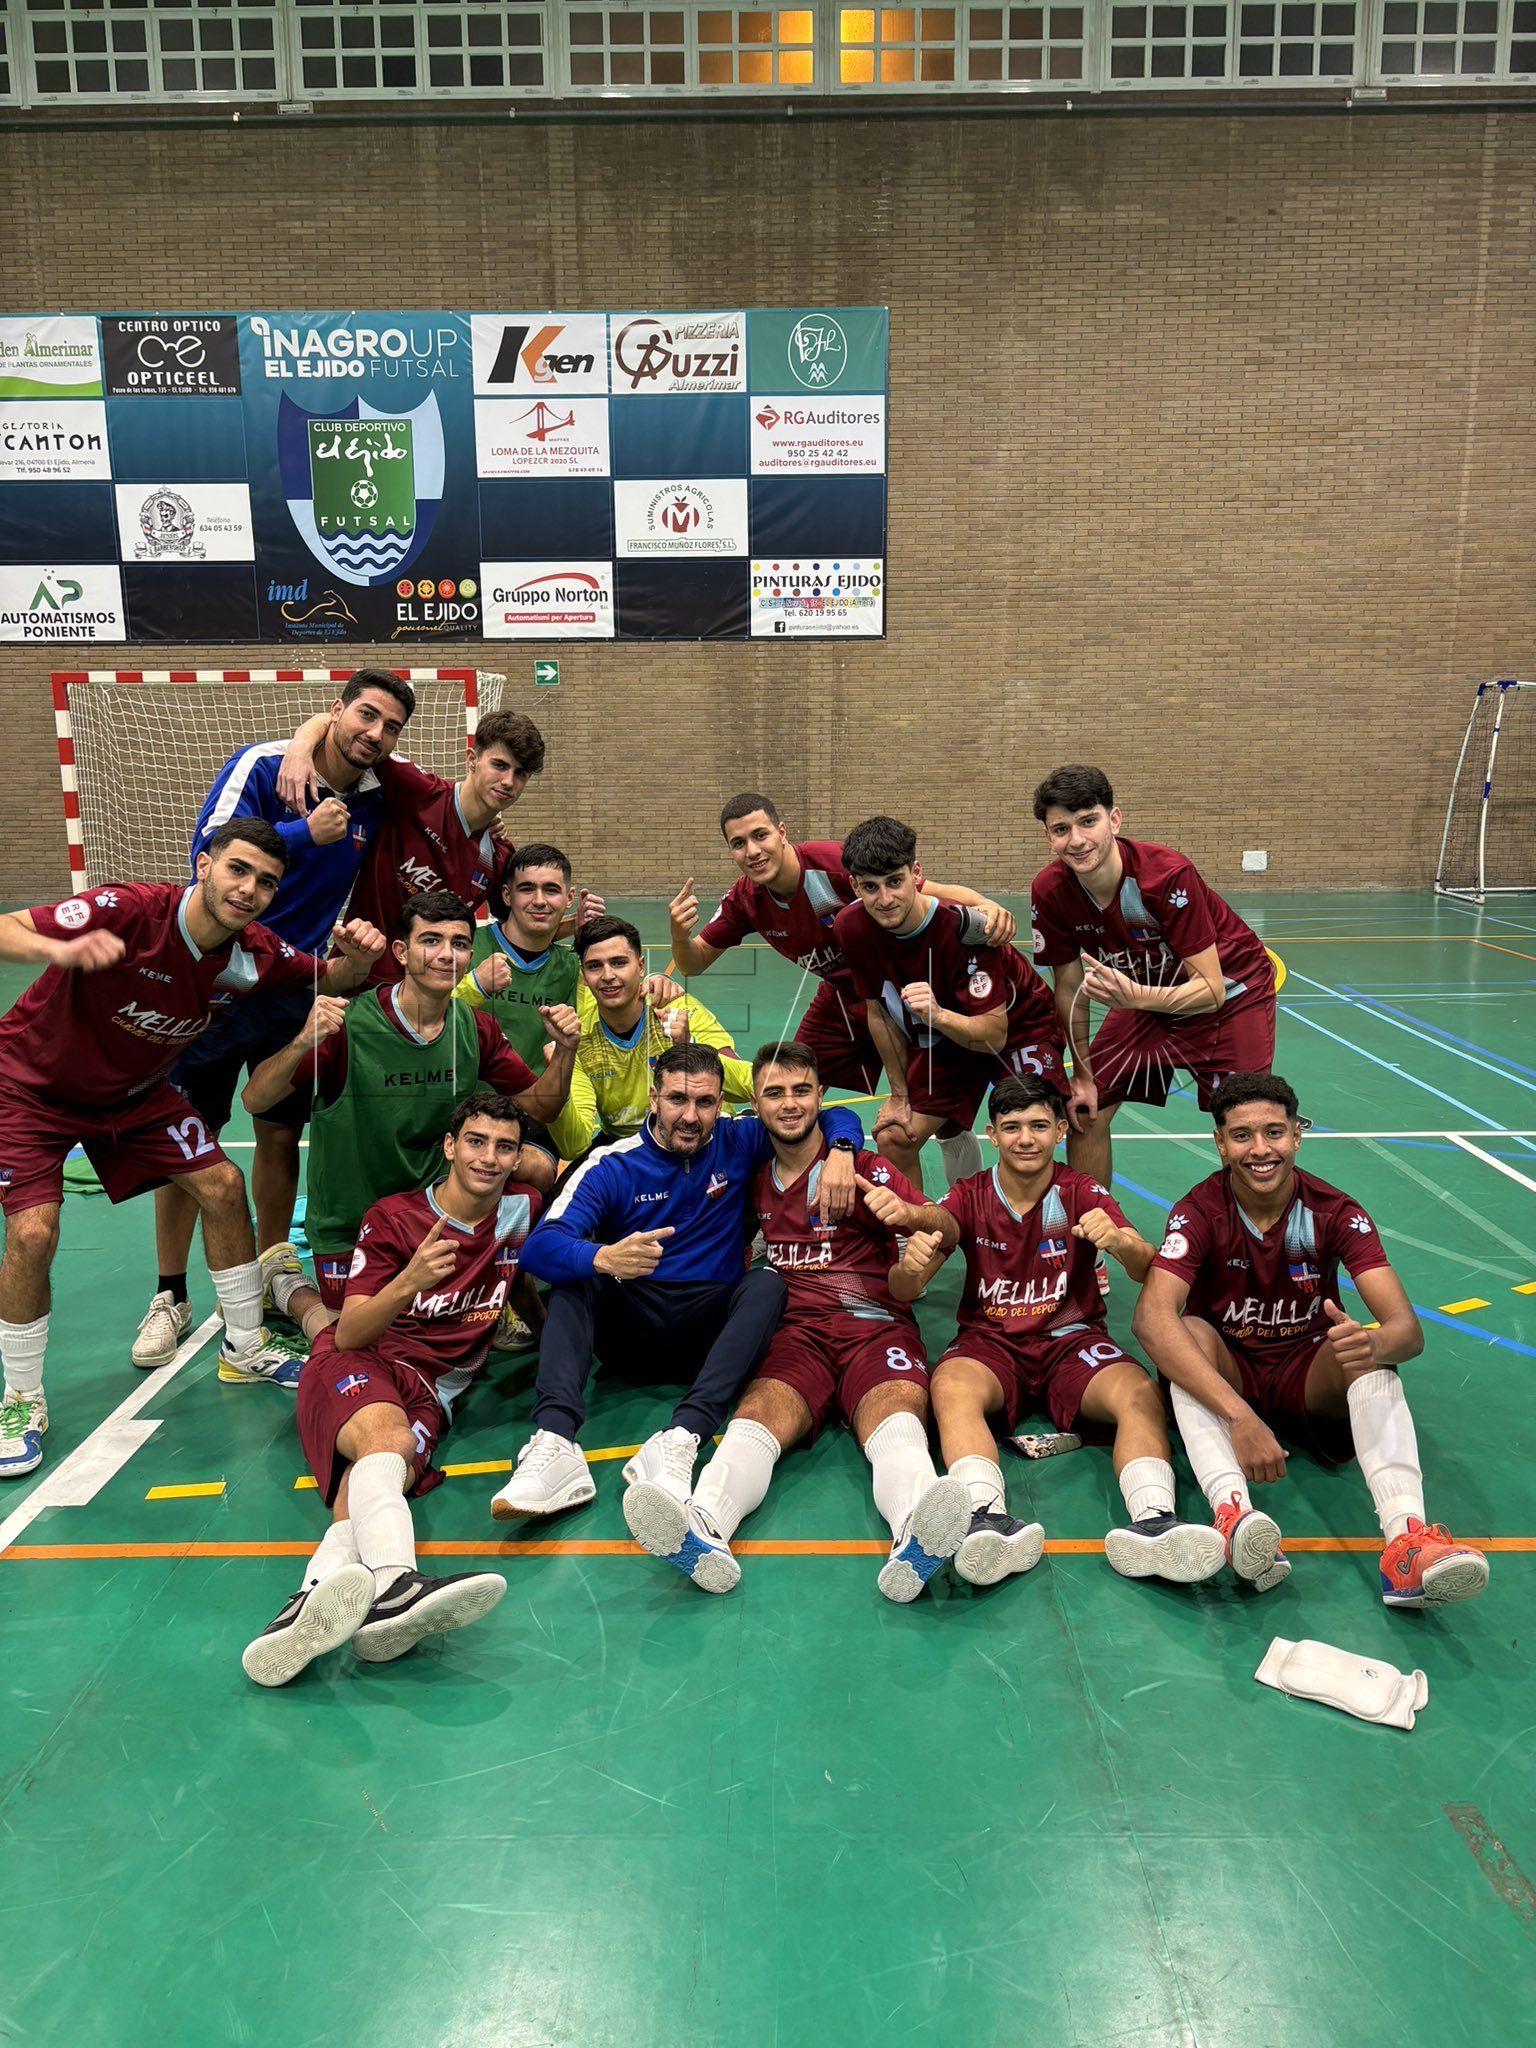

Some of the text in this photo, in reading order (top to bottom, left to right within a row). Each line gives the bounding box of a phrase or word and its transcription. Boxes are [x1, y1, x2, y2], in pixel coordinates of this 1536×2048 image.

[118, 320, 221, 332] CENTRO OPTICO
[675, 321, 740, 340] PIZZERIA
[24, 332, 93, 357] Almerimar
[39, 360, 93, 368] ORNAMENTALES
[264, 359, 459, 378] EL EJIDO FUTSAL
[127, 371, 220, 386] OPTICEEL
[668, 380, 741, 391] Almerimar
[2, 422, 64, 430] GESTORIA
[313, 422, 406, 432] CLUB DEPORTIVO
[772, 438, 864, 448] www.rgauditores.eu
[491, 446, 600, 456] LOMA DE LA MEZQUITA
[787, 449, 849, 458] 950 25 42 42
[758, 458, 877, 468] auditores@rgauditores.eu
[647, 484, 715, 531] SUMINISTROS AGRICOLAS
[320, 515, 411, 527] FUTSAL
[668, 540, 694, 549] MUÑOZ
[753, 574, 881, 590] PINTURAS EJIDO
[266, 578, 308, 601] imd
[493, 587, 609, 606] Gruppo Norton
[1, 612, 116, 625] AUTOMATISMOS
[396, 602, 478, 621] EL EJIDO
[564, 614, 594, 623] Aperture
[784, 609, 848, 617] Tel. 620 19 95 65
[23, 626, 96, 638] PONIENTE
[1010, 1044, 1044, 1077] 15
[384, 1068, 455, 1088] KELME
[166, 1116, 216, 1161] 12
[634, 1190, 670, 1204] KELME
[979, 1271, 1068, 1306] MELILLA
[412, 1280, 508, 1320] MELILLA
[1011, 1307, 1028, 1317] DEL
[886, 1346, 913, 1371] 8
[1077, 1342, 1124, 1369] 10
[411, 1419, 432, 1454] 5
